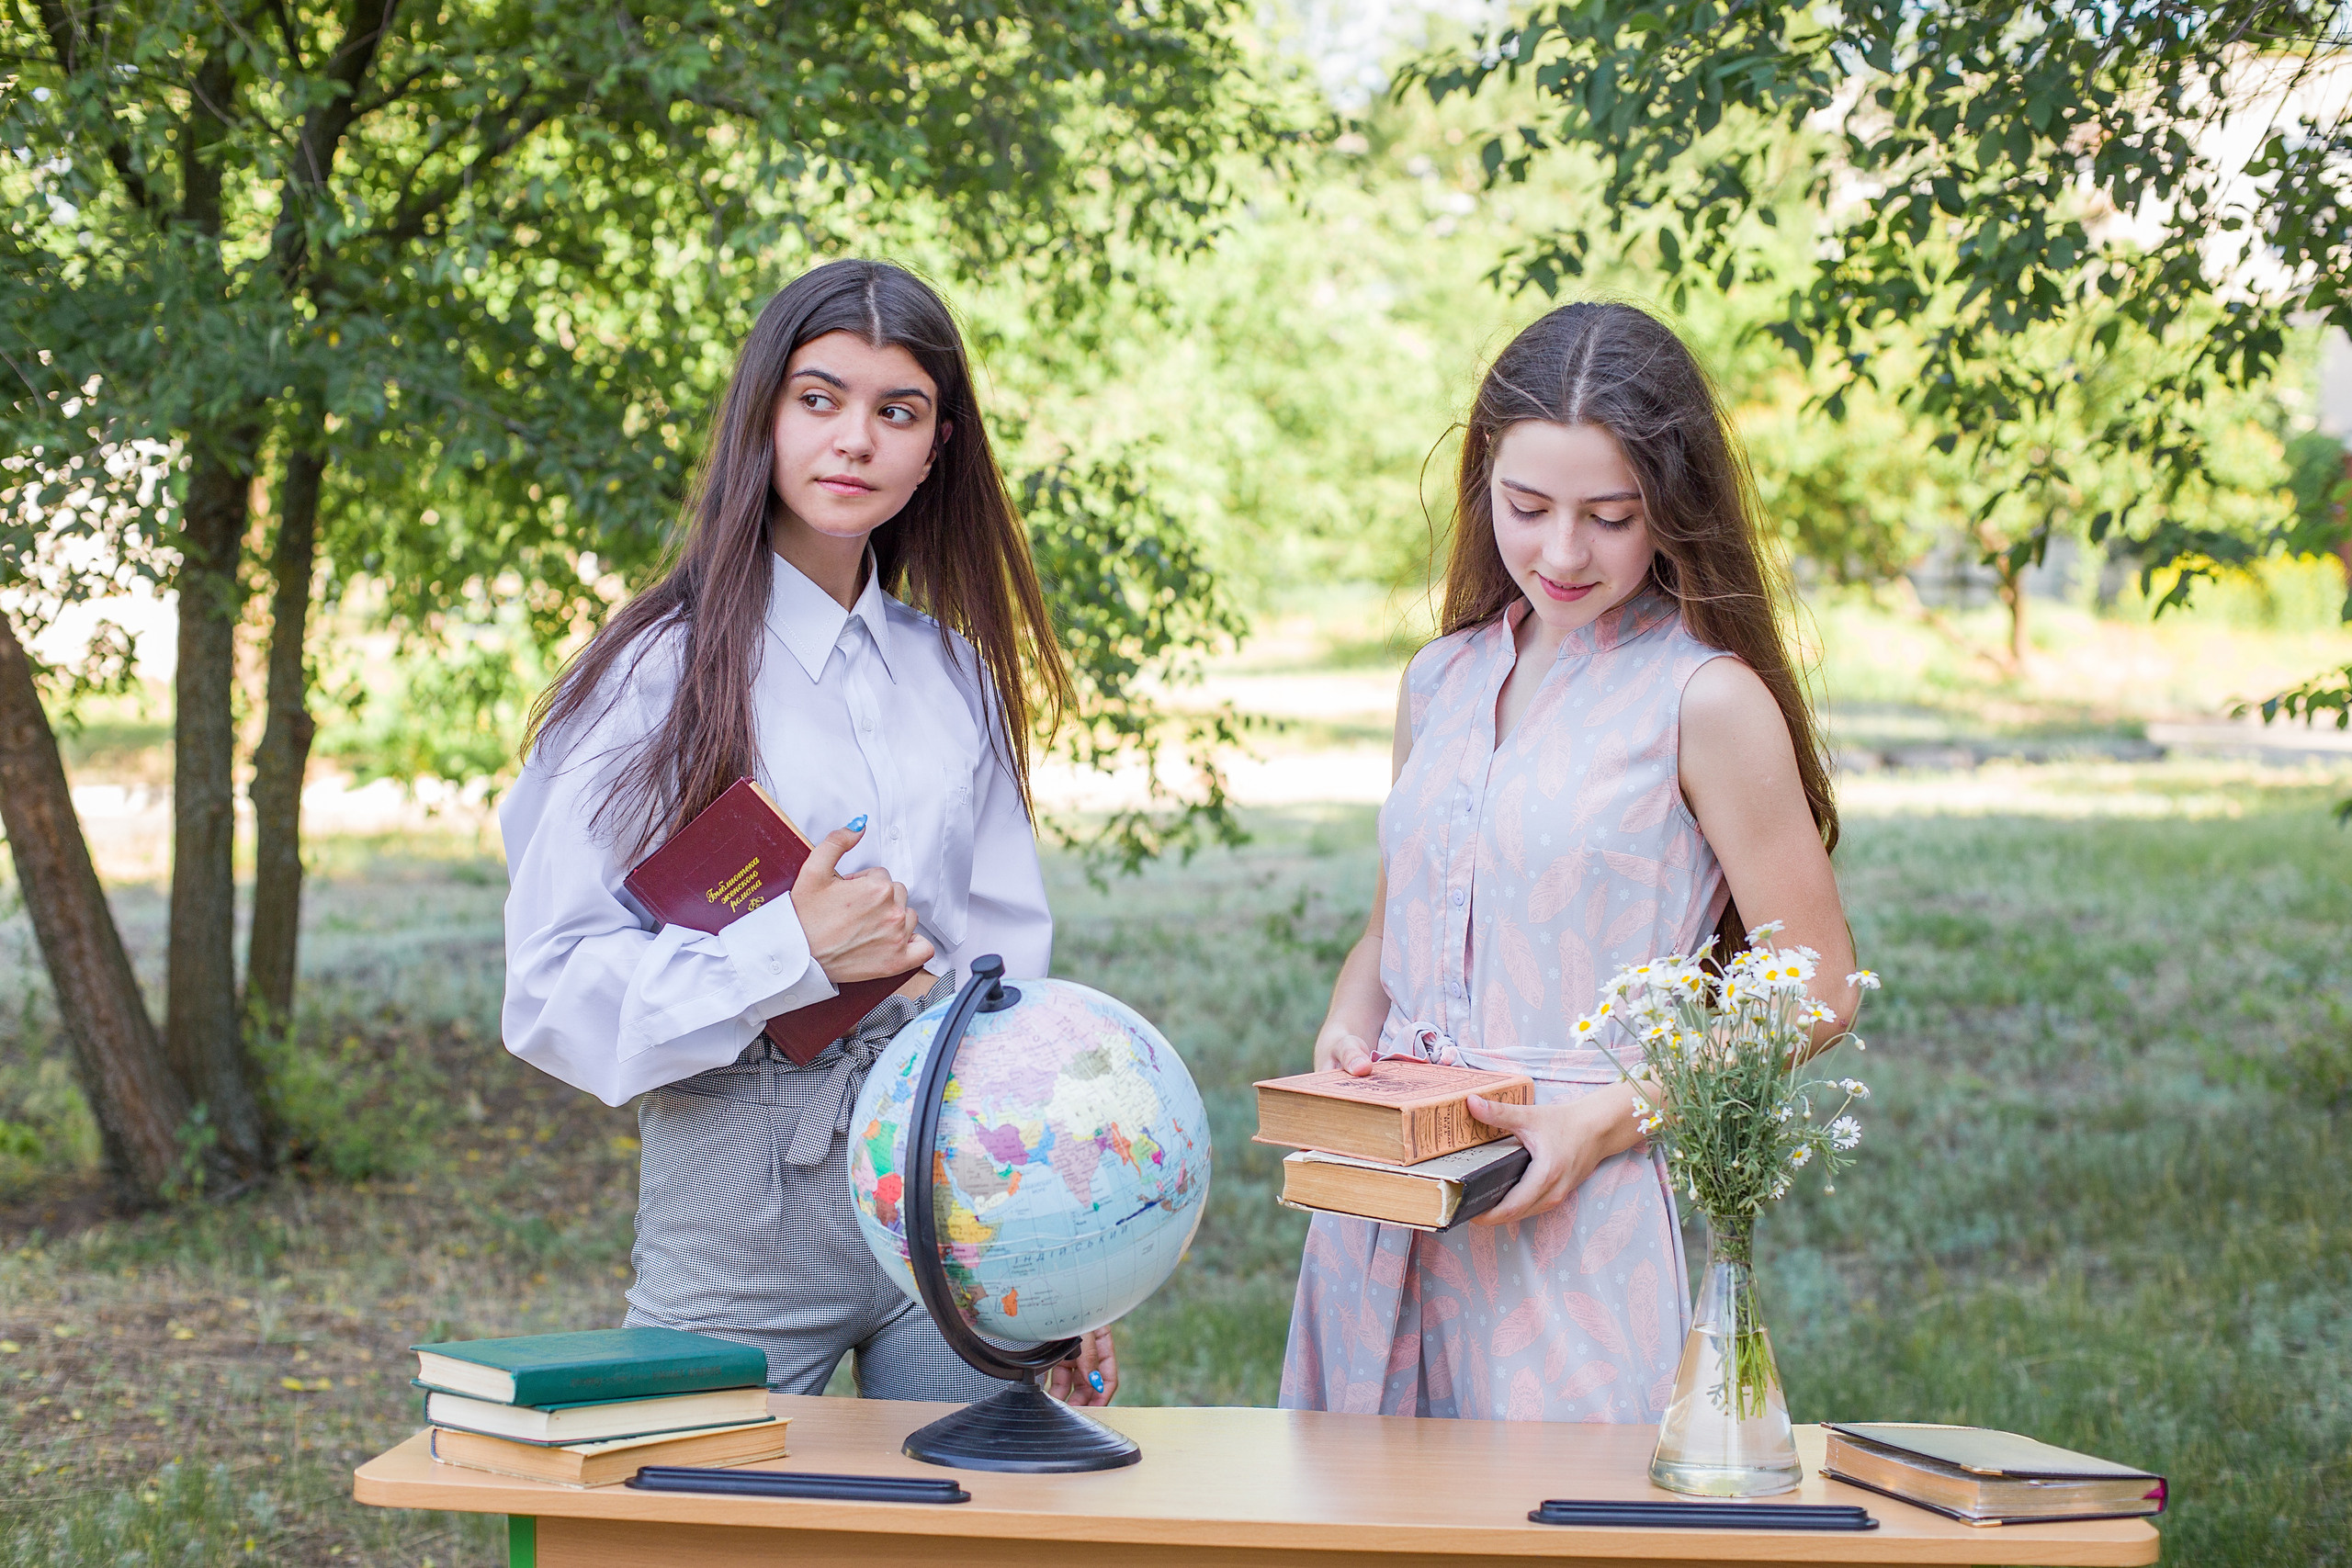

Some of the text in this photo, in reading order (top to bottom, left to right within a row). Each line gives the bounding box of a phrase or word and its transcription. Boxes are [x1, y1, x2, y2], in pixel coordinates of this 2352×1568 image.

[706, 856, 761, 904] Библиотека
[721, 870, 759, 905] женского
[729, 879, 763, 913] романа
